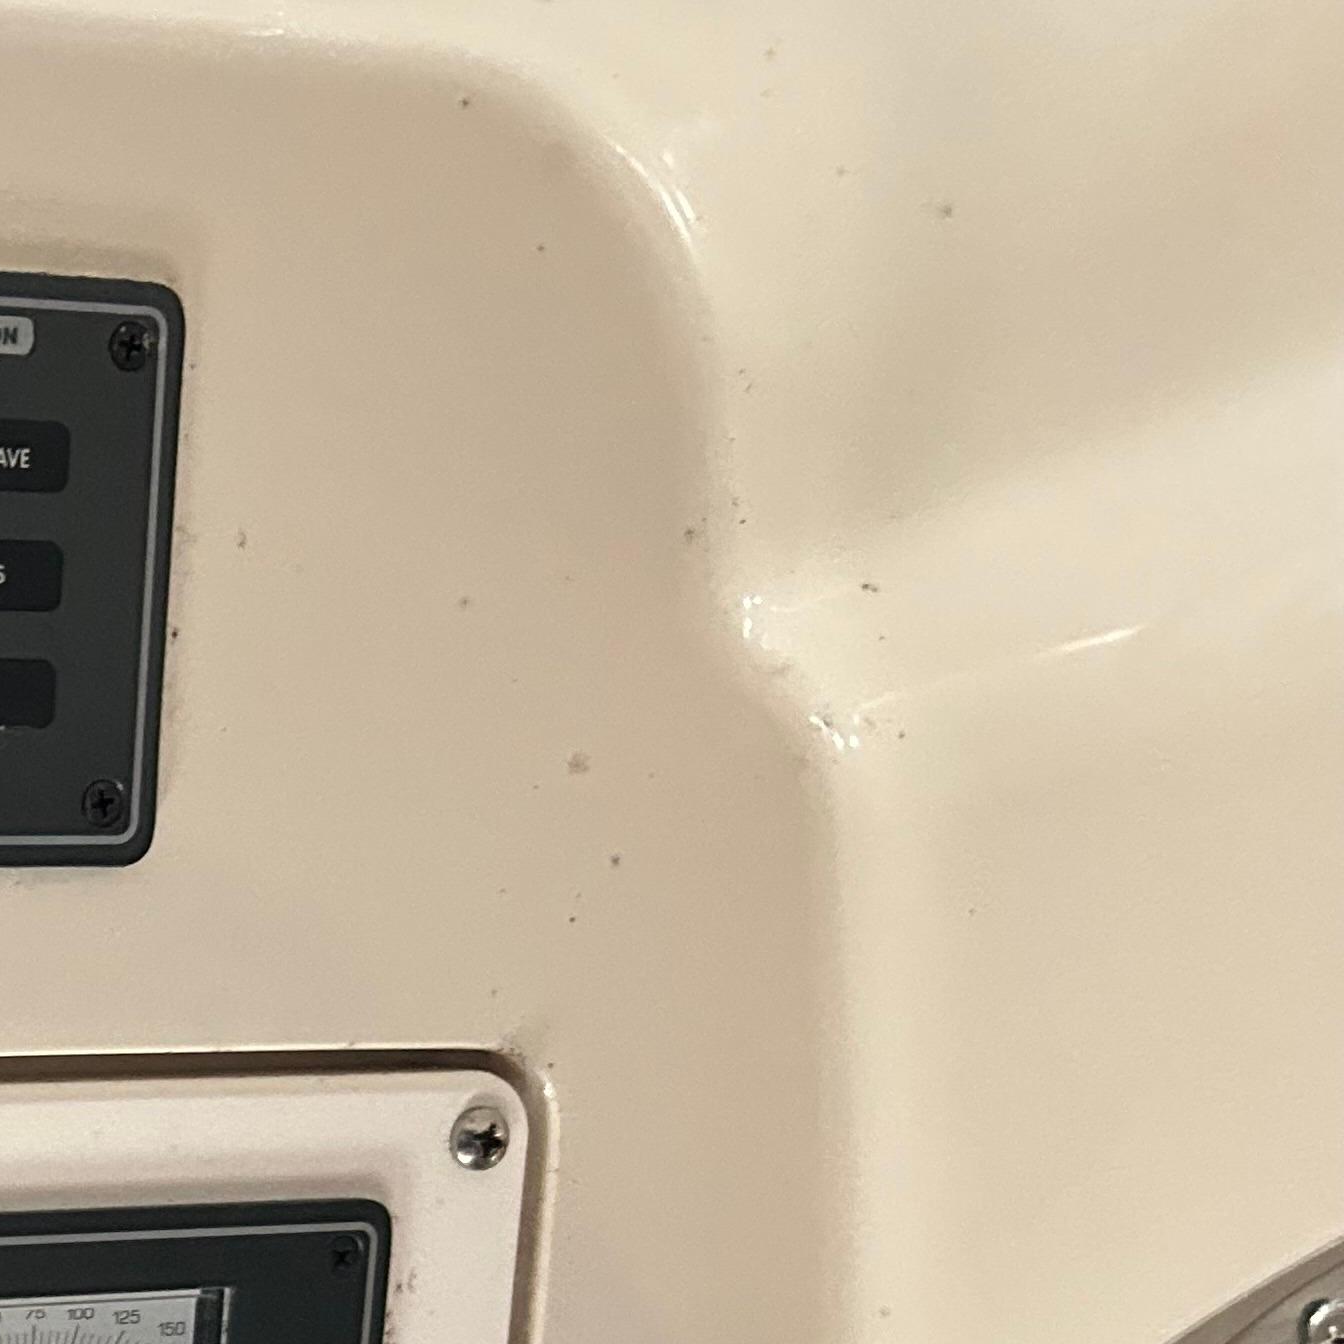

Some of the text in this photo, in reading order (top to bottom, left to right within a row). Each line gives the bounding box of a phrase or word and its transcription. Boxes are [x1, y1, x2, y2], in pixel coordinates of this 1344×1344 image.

[67, 1308, 95, 1320] 100
[114, 1310, 141, 1324] 125
[160, 1322, 186, 1337] 150
